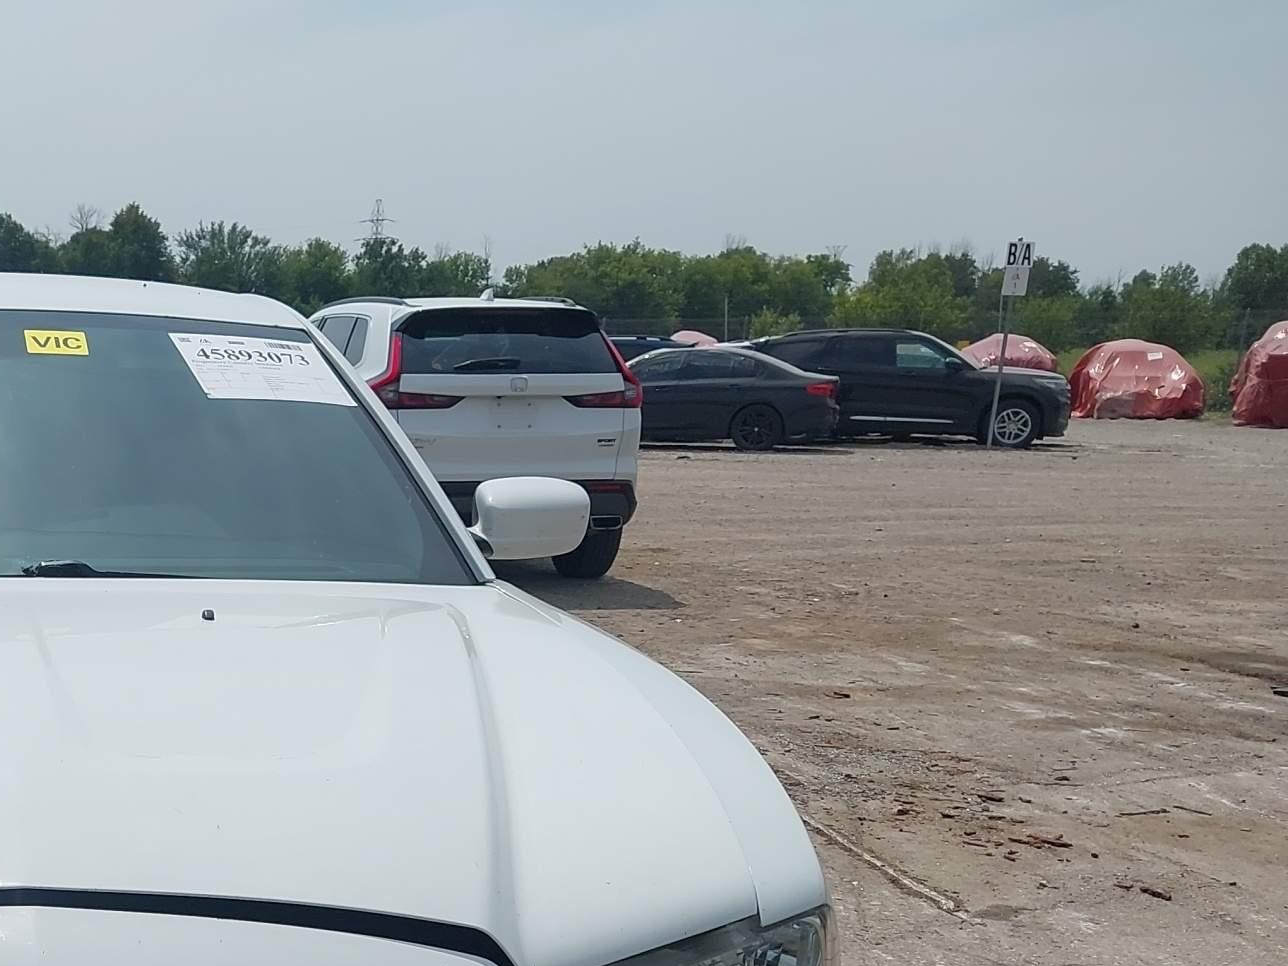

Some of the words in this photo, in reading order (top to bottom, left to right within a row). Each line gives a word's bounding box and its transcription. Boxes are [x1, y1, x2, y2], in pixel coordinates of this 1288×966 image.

[1007, 242, 1031, 266] B/A
[31, 336, 83, 350] VIC
[196, 348, 310, 366] 45893073
